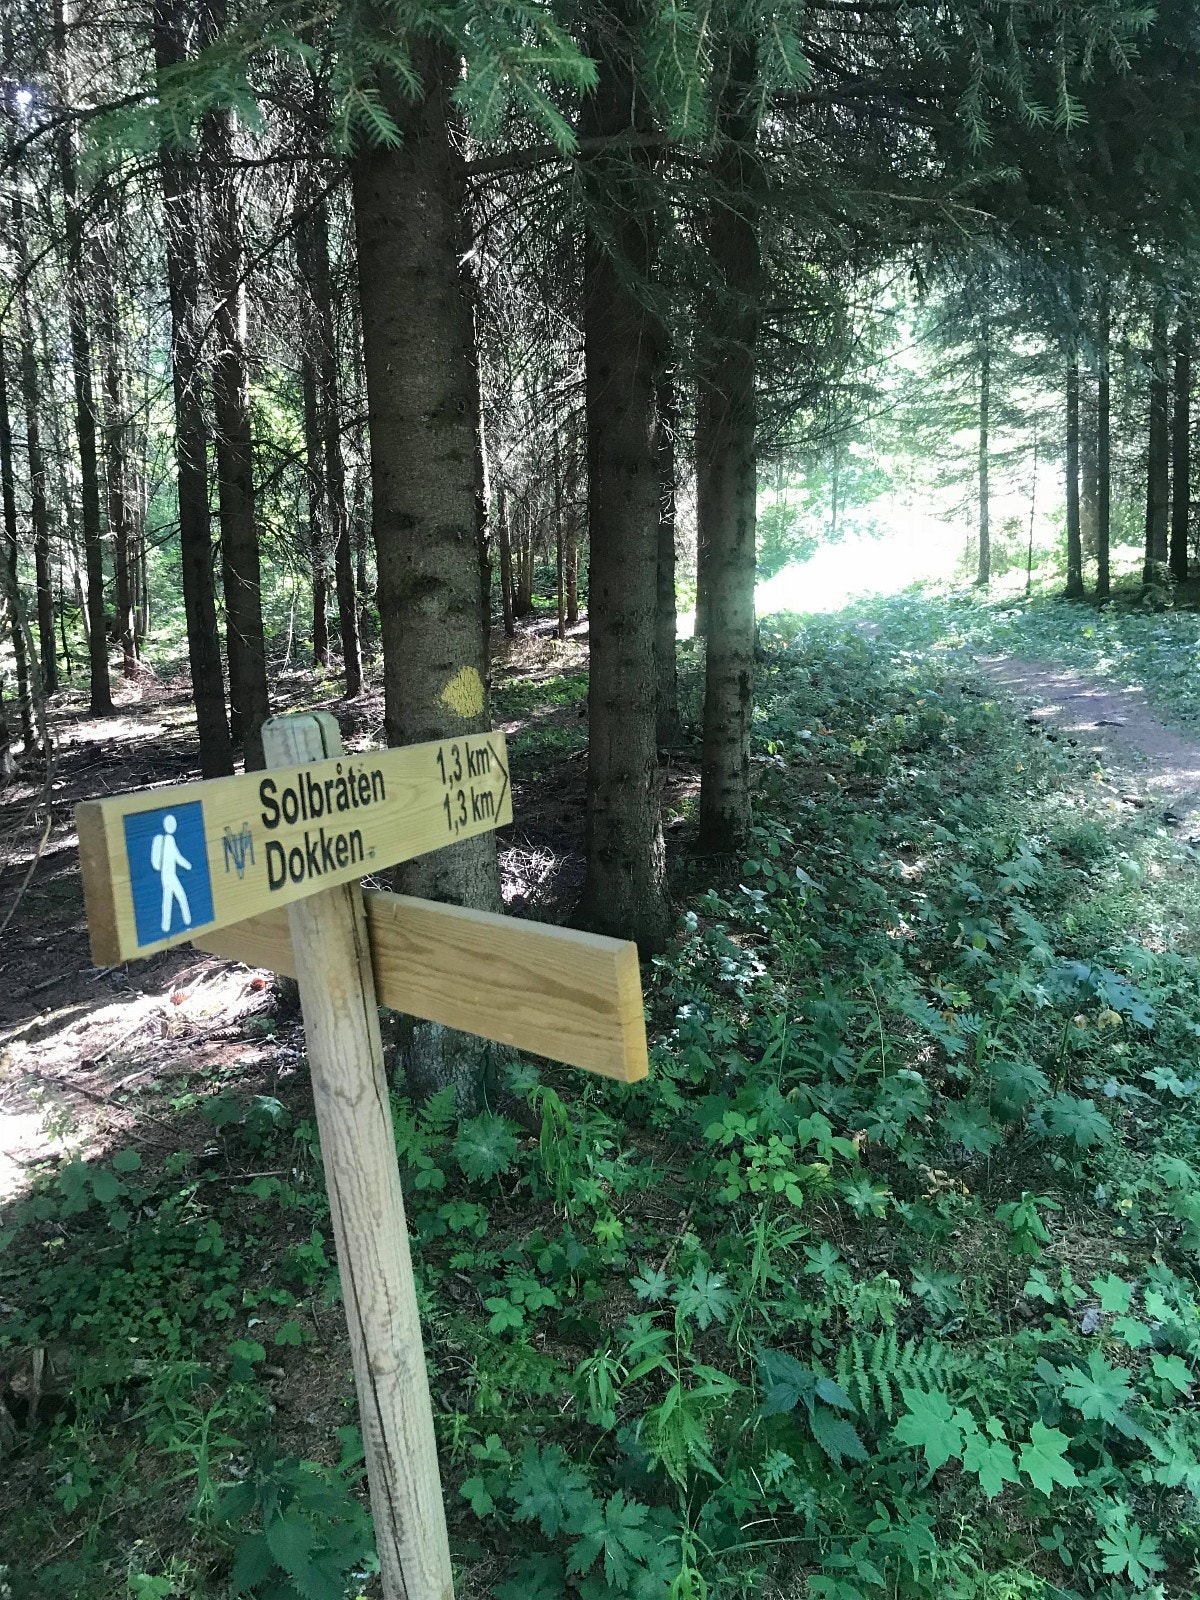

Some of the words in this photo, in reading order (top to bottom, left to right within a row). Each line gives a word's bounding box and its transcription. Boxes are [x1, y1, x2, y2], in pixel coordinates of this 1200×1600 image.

[259, 762, 386, 830] Solbråten
[436, 744, 463, 791] 1,3
[465, 741, 491, 778] km
[264, 827, 365, 892] Dokken
[443, 789, 468, 836] 1,3
[470, 786, 495, 822] km
